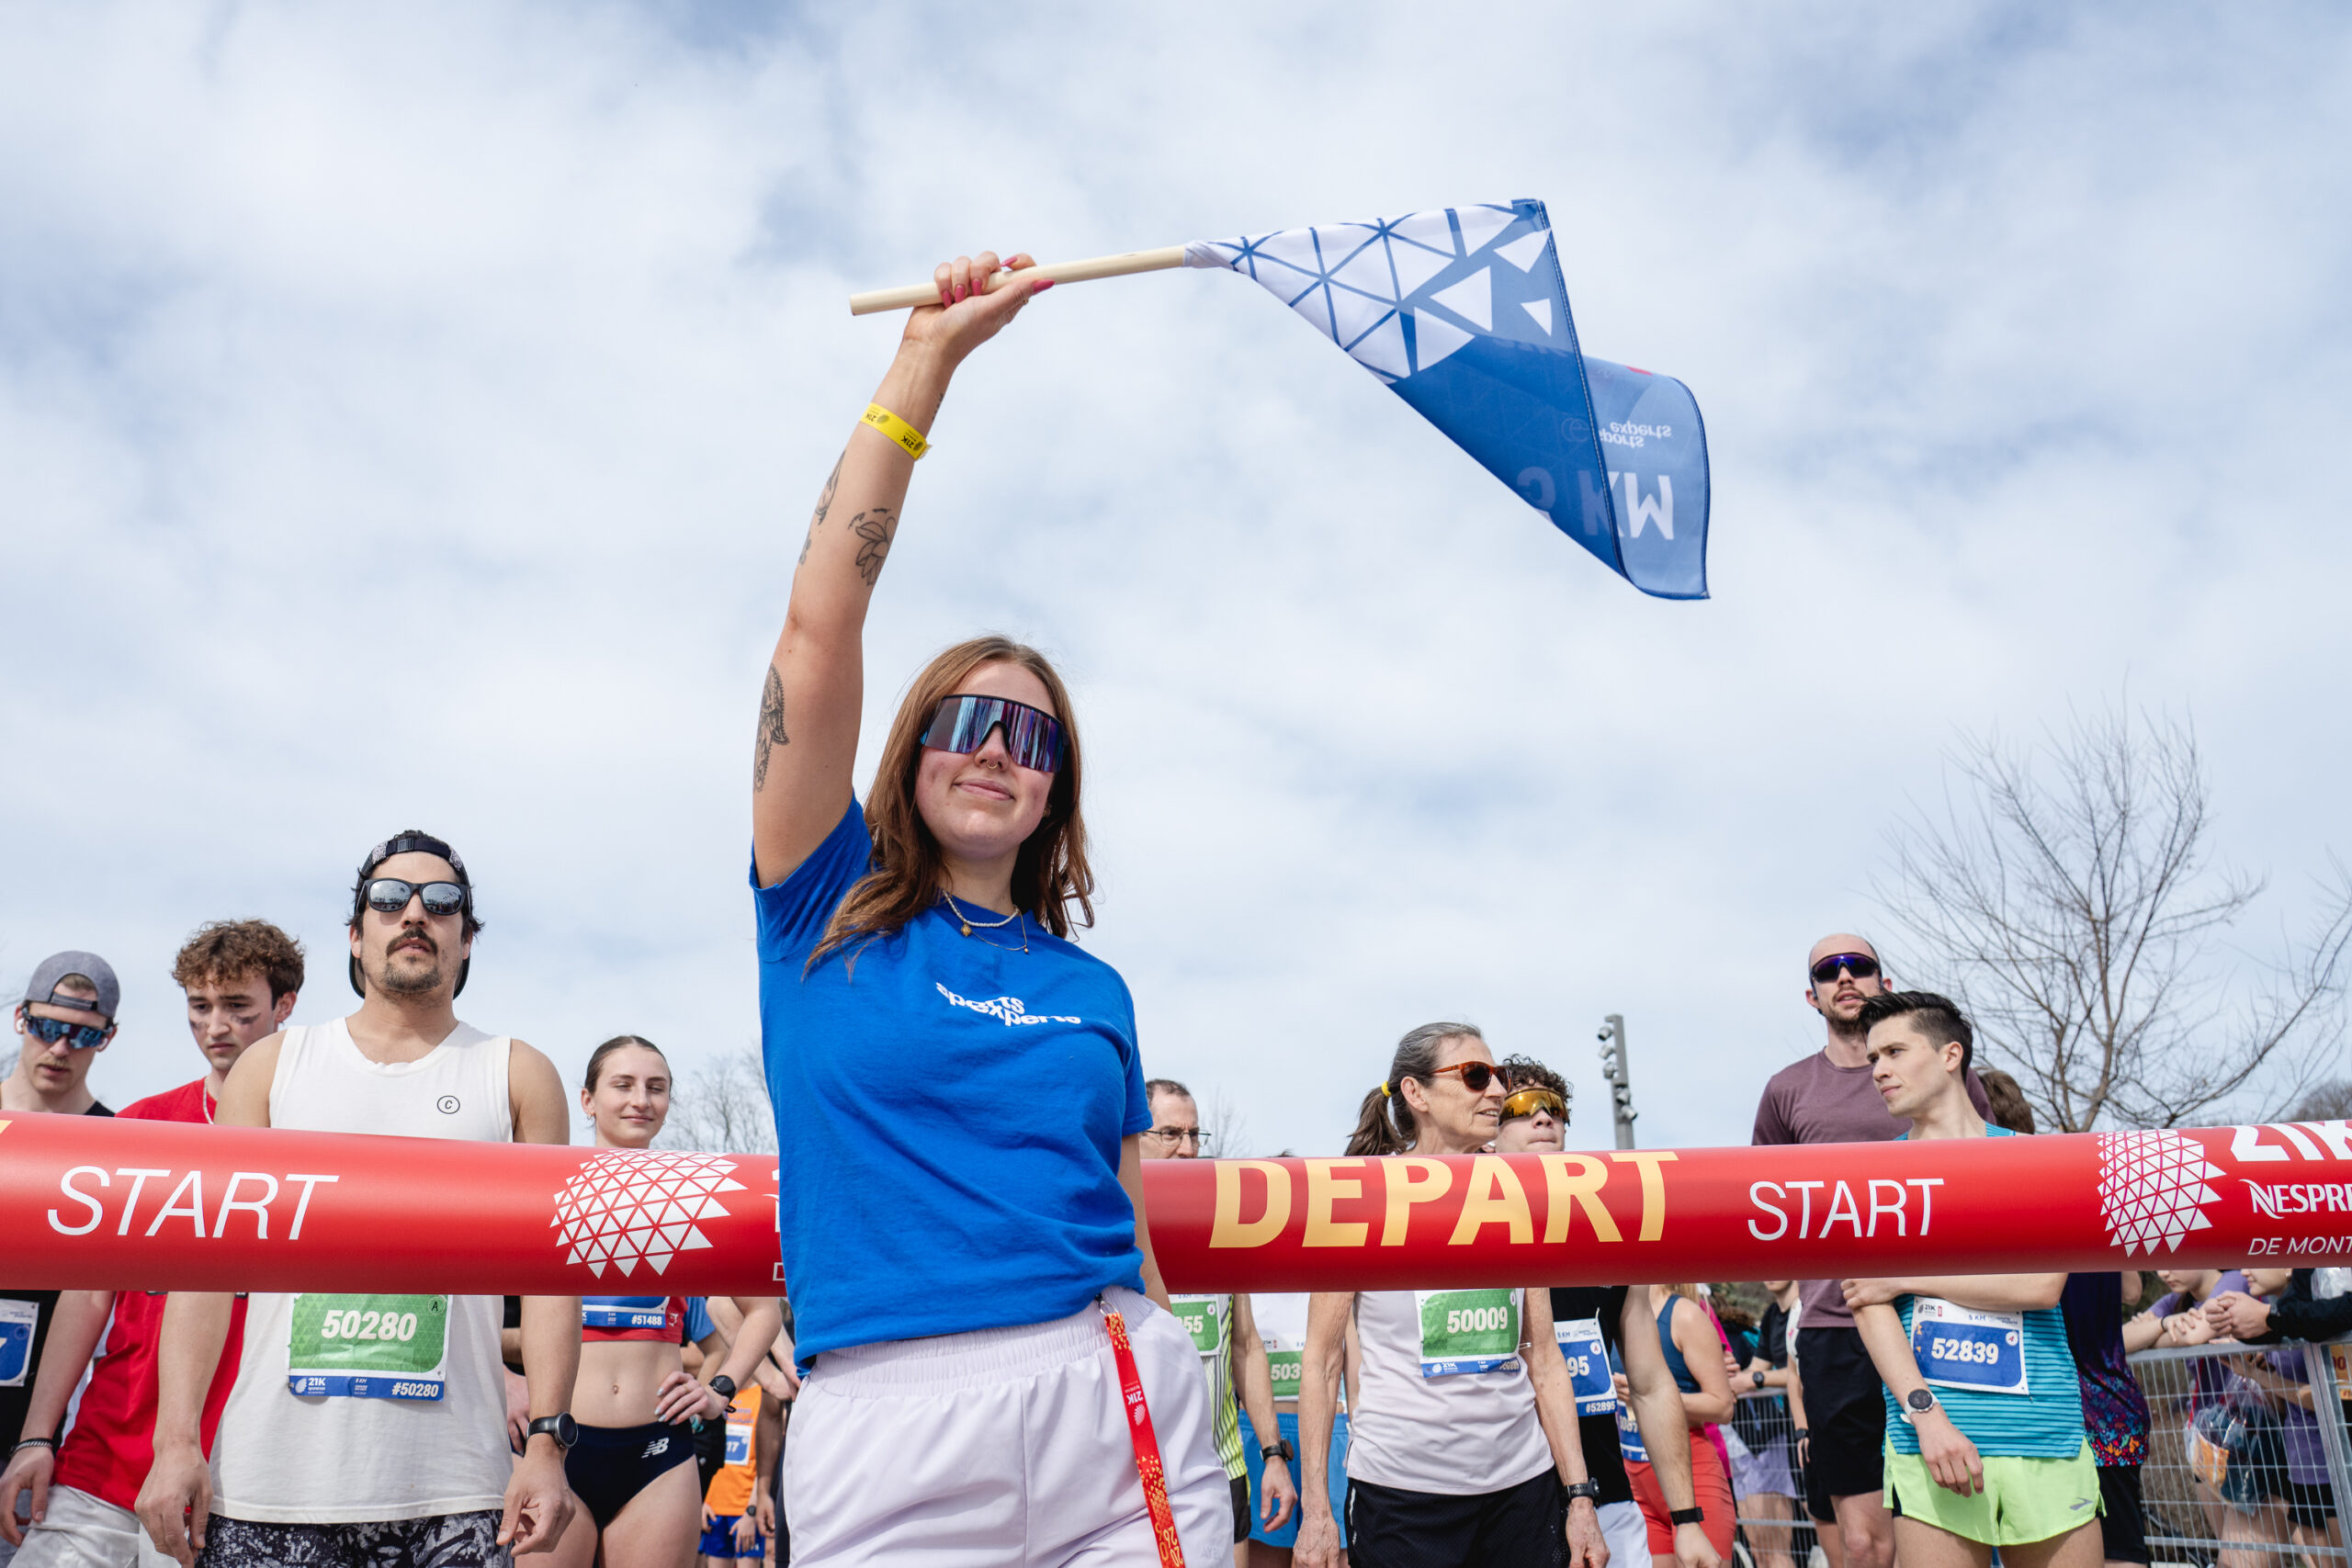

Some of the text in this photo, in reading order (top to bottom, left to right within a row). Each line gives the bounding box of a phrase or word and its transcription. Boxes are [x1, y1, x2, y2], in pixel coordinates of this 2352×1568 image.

[48, 1166, 340, 1240] START
[1208, 1151, 1679, 1248] DEPART
[1747, 1178, 1944, 1241] START
[2247, 1237, 2282, 1256] DE
[322, 1309, 418, 1341] 50280
[631, 1314, 662, 1325] #51488
[1446, 1306, 1508, 1334] 50009
[1931, 1337, 1999, 1365] 52839
[308, 1377, 326, 1386] 21K
[391, 1382, 439, 1398] #50280
[1126, 1390, 1144, 1405] 21K
[1586, 1400, 1616, 1414] #52895
